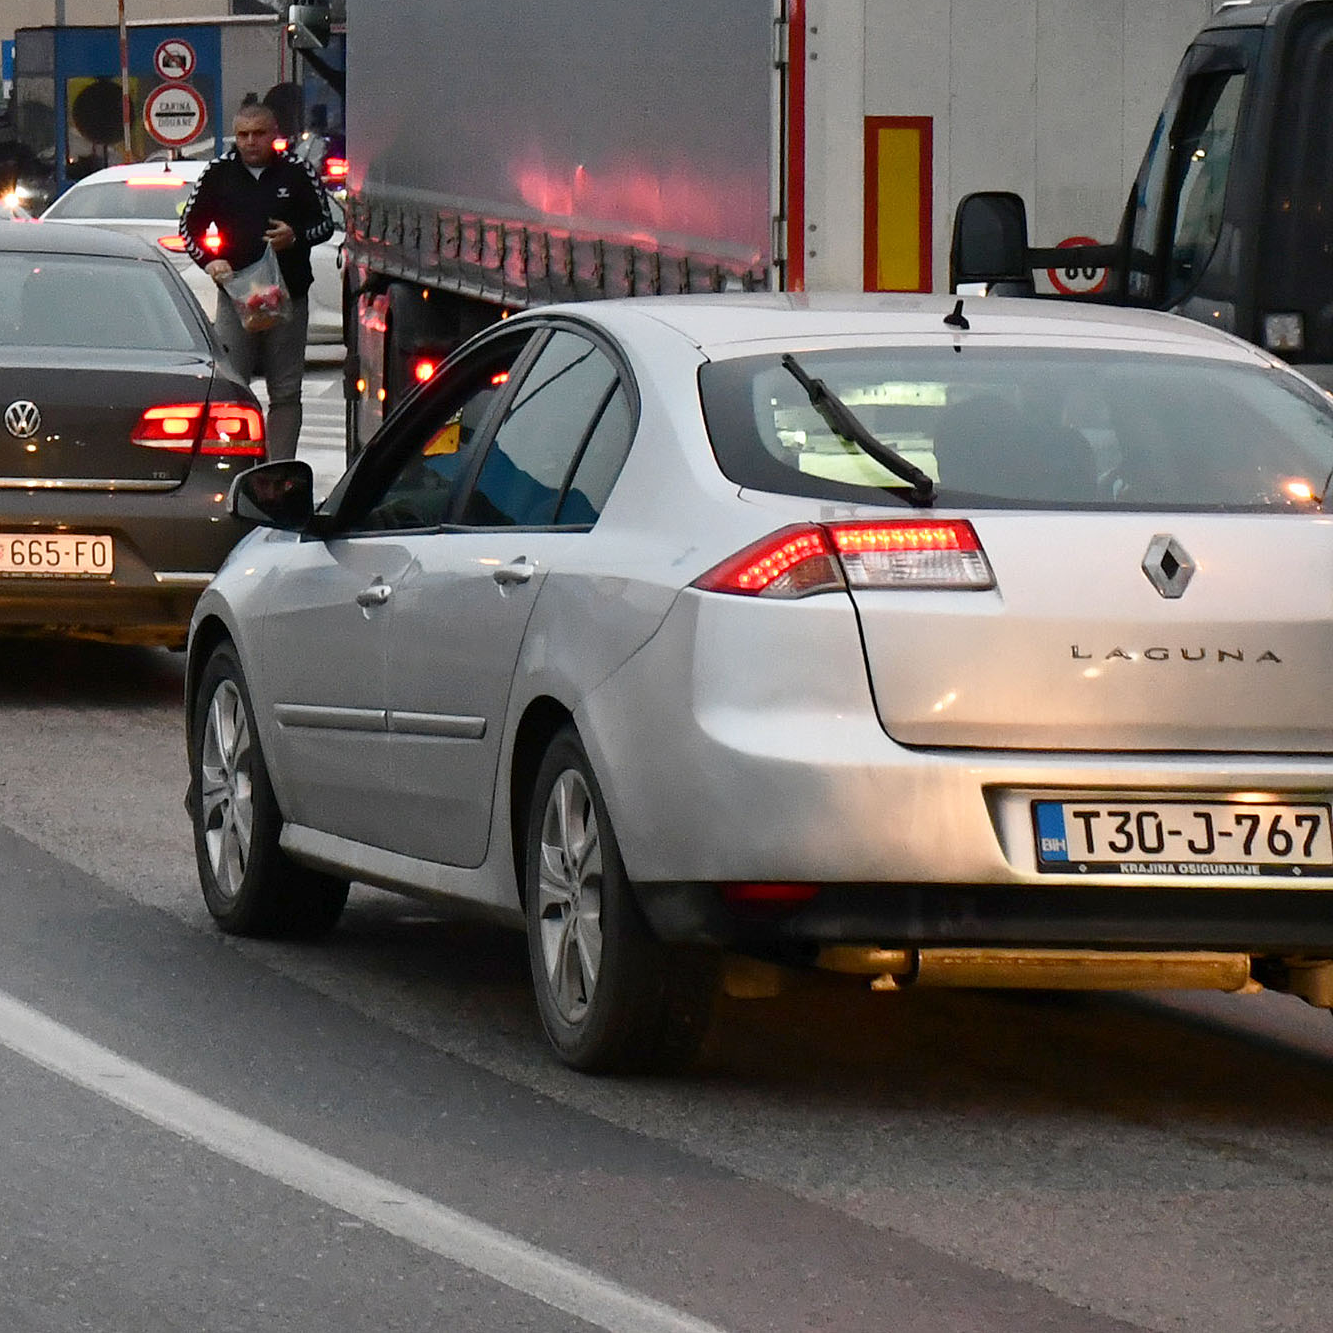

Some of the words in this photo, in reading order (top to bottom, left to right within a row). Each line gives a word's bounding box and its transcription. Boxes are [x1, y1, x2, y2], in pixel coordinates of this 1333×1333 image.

[159, 102, 191, 112] CARINA
[1070, 644, 1283, 664] LAGUNA
[1041, 837, 1067, 852] BIH
[1119, 863, 1176, 875] KRAJINA
[1178, 863, 1261, 876] OSIGURANJE
